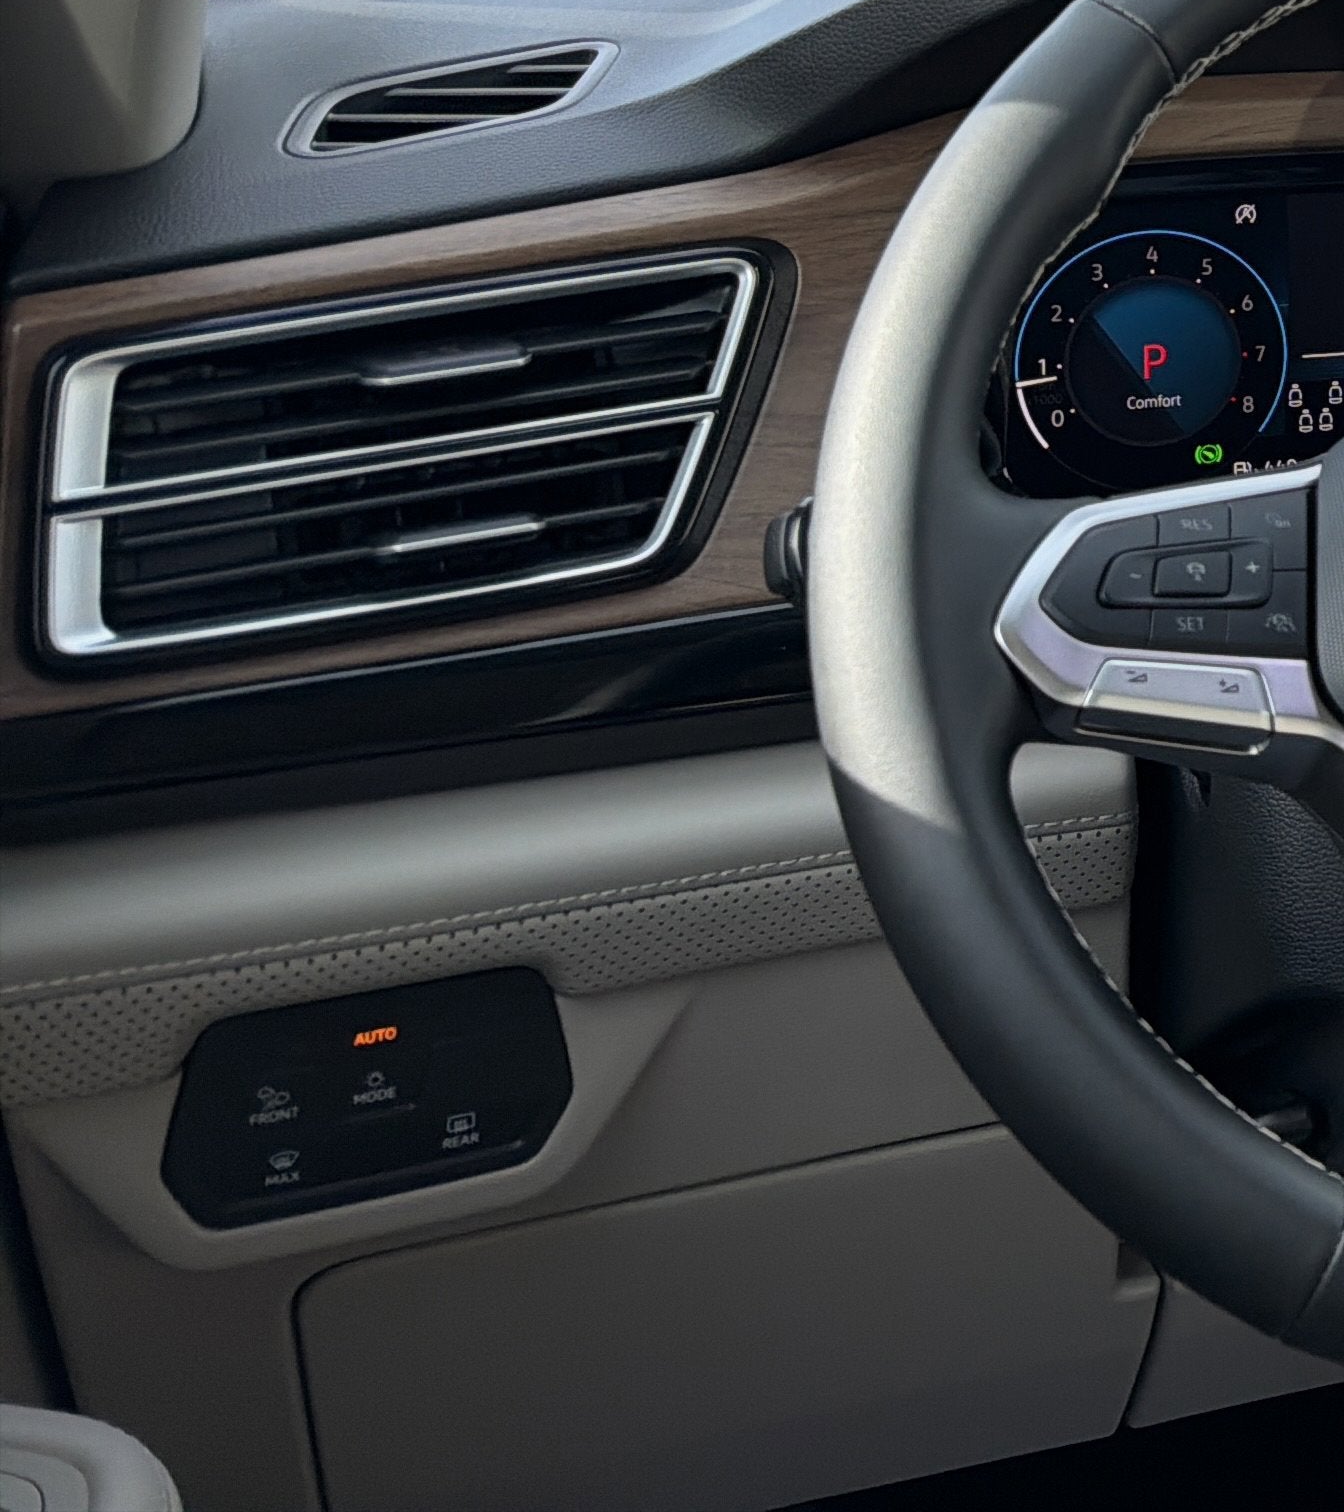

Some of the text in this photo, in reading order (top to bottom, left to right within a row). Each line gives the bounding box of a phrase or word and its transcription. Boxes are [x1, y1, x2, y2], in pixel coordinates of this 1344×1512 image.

[1145, 246, 1159, 263] 4
[1091, 263, 1104, 282] 3
[1201, 258, 1213, 276] 5
[1241, 294, 1254, 312] 6
[1050, 304, 1063, 322] 2
[1142, 343, 1169, 381] P
[1254, 345, 1267, 363] 7
[1037, 358, 1047, 376] 1
[1126, 394, 1183, 410] Comfort
[1241, 395, 1255, 414] 8
[1050, 409, 1065, 428] 0
[1180, 518, 1213, 531] RES
[1176, 616, 1204, 631] SET
[353, 1026, 398, 1047] AUTO
[353, 1086, 398, 1105] MODE
[249, 1106, 299, 1126] FRONT
[442, 1132, 480, 1149] REAR
[264, 1171, 300, 1187] MAX
